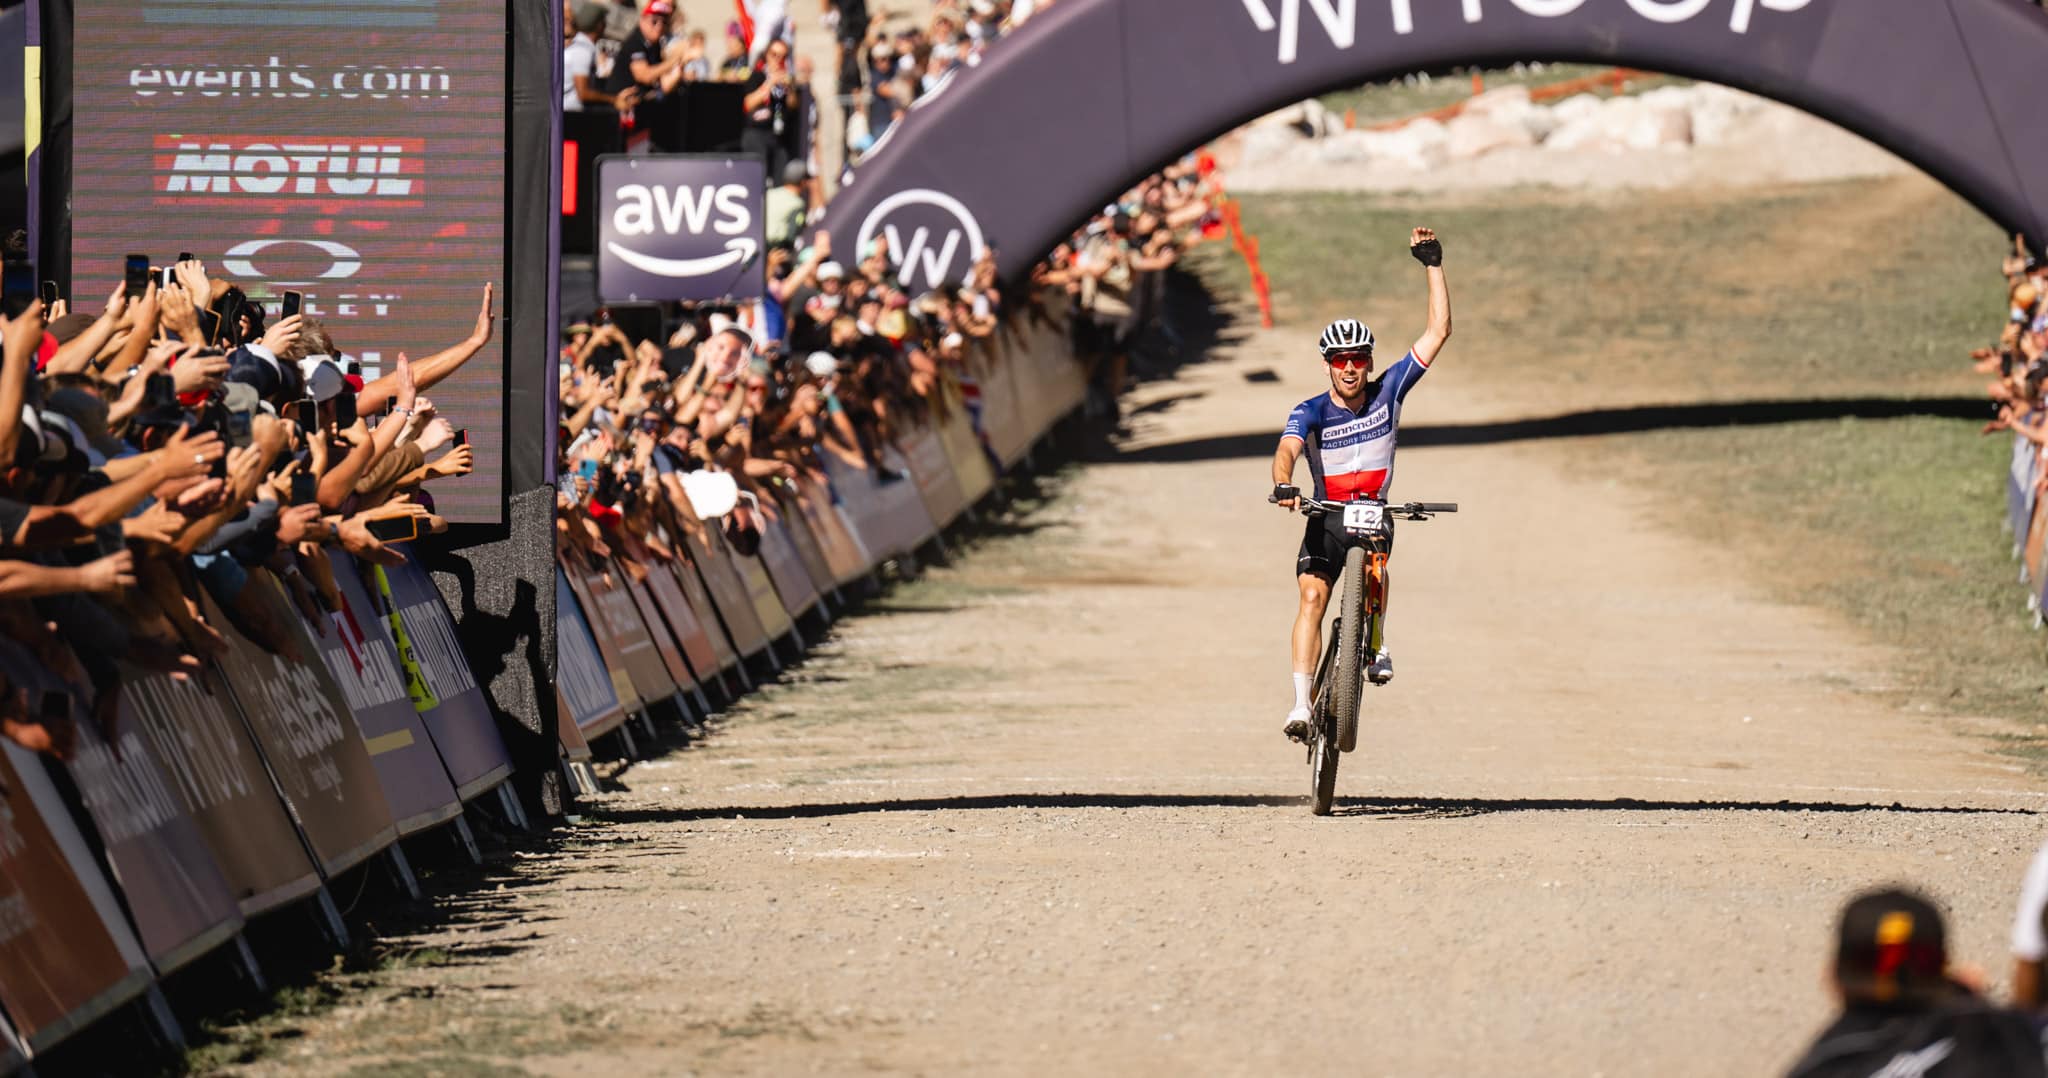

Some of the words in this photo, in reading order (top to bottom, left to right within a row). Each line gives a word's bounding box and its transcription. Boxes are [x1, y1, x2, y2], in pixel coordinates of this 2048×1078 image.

[129, 55, 450, 99] events.com
[166, 143, 412, 196] MOTUL
[613, 183, 751, 236] aws
[1321, 437, 1359, 449] FACTORY
[1361, 424, 1390, 441] RACING
[1323, 408, 1388, 438] cannondale
[1352, 508, 1377, 525] 12
